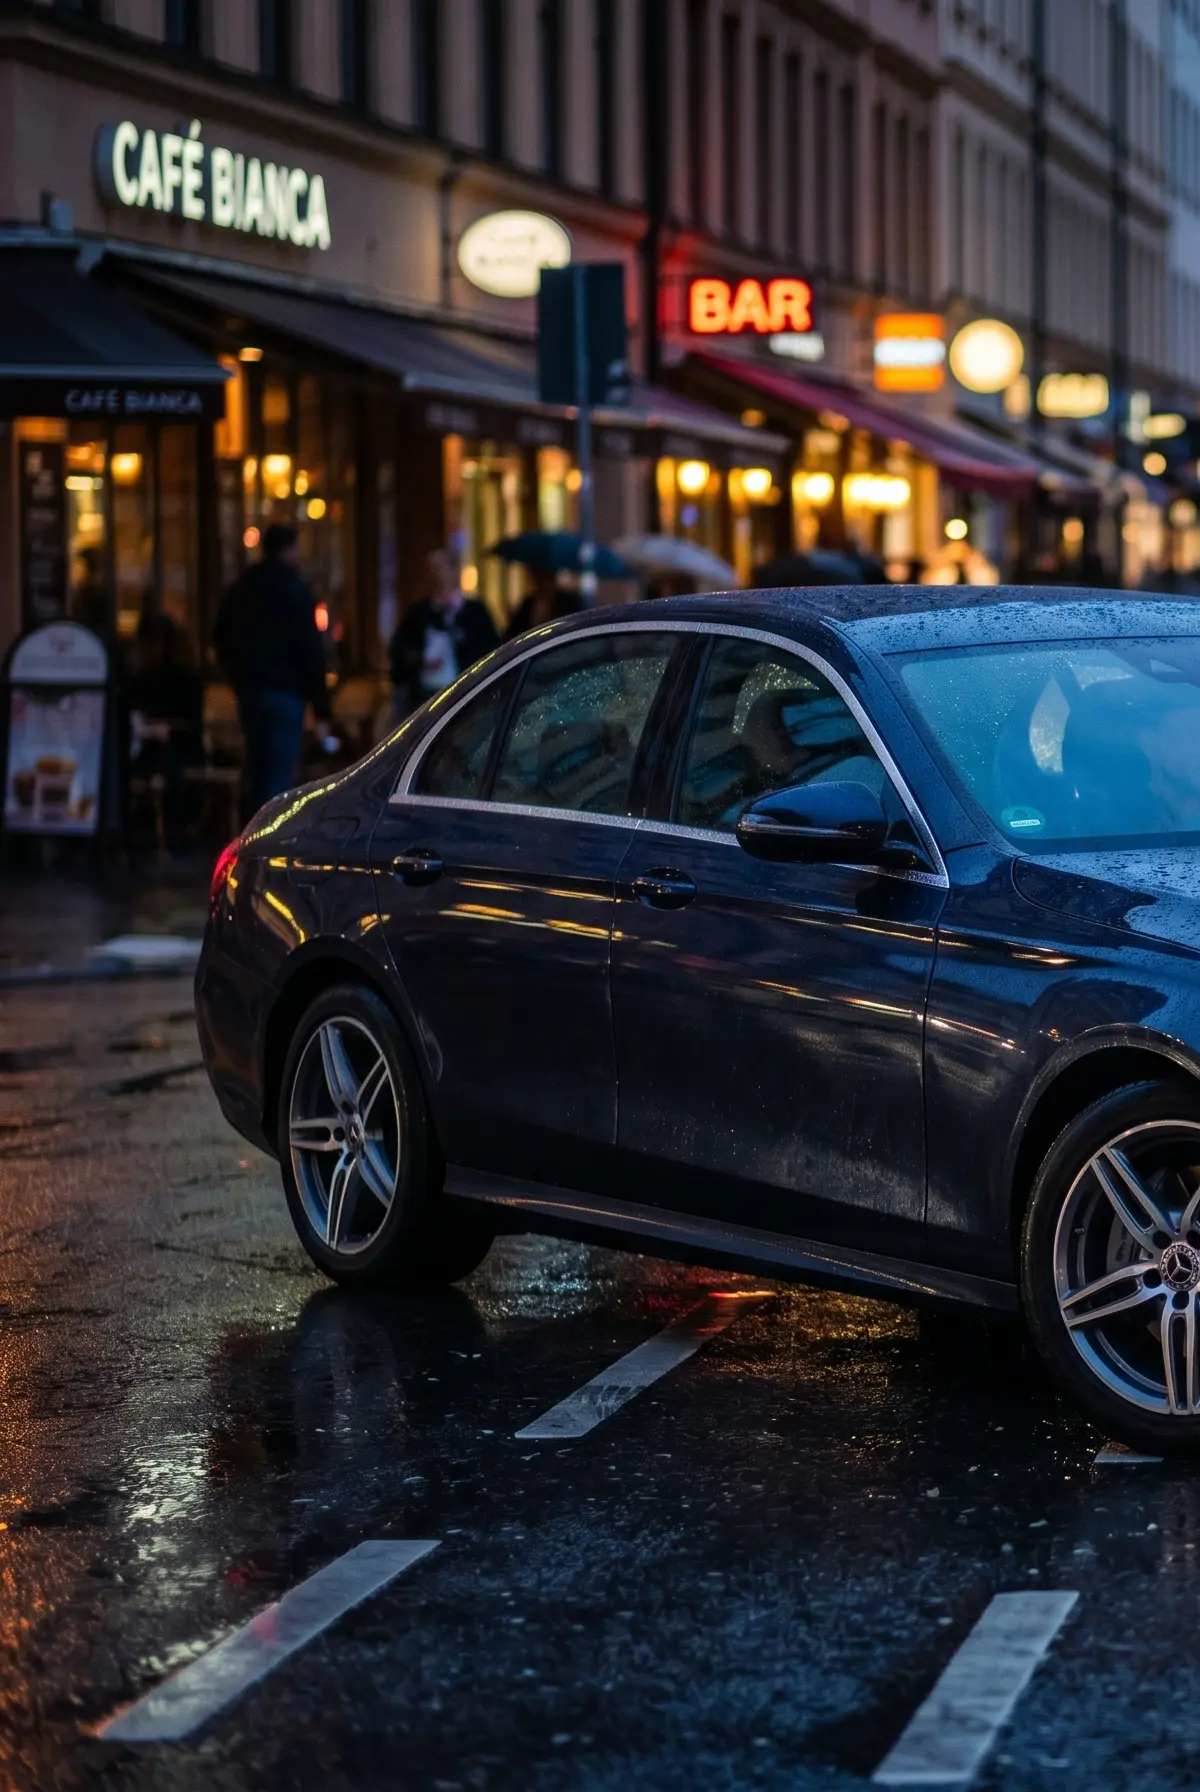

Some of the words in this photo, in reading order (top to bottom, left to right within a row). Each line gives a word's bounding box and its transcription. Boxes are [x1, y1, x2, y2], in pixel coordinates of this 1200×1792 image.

[112, 118, 205, 221] CAFÉ
[212, 146, 332, 250] BIANCA
[690, 278, 811, 334] BAR
[124, 389, 203, 414] BIANCA
